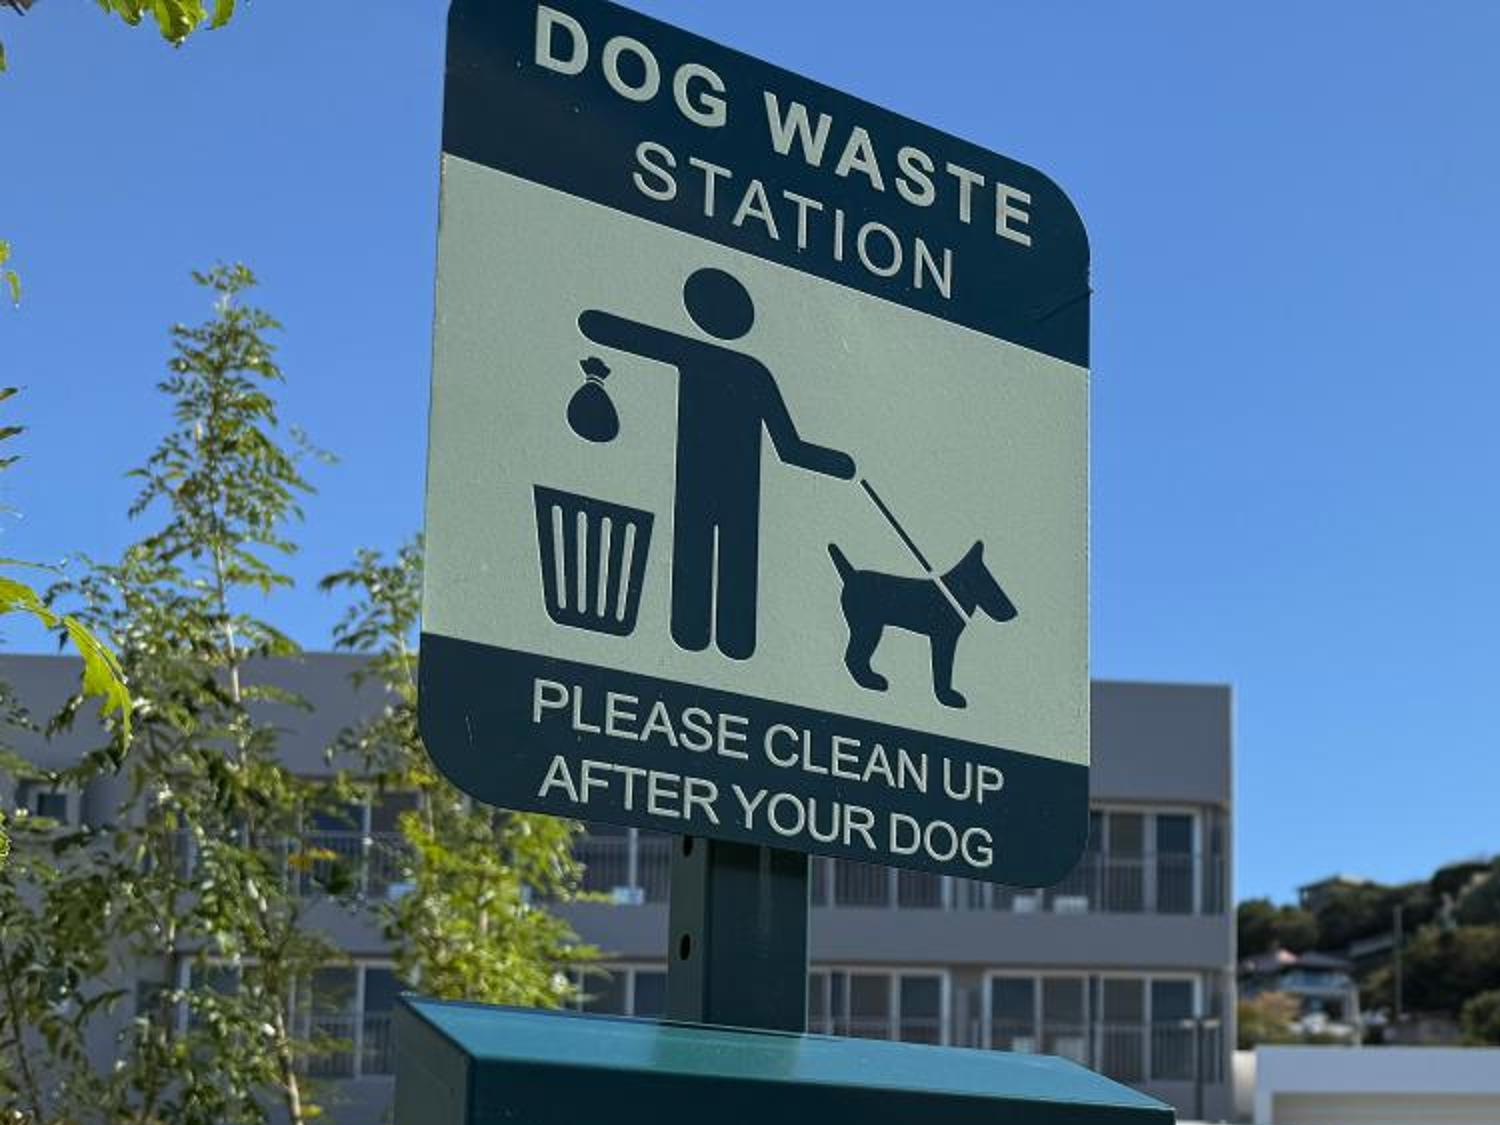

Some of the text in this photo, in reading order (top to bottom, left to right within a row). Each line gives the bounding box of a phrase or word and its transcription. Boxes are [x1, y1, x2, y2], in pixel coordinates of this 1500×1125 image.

[535, 5, 1032, 246] DOG WASTE
[632, 140, 953, 299] STATION
[532, 677, 1003, 808] PLEASE CLEAN UP
[537, 755, 994, 869] AFTER YOUR DOG
